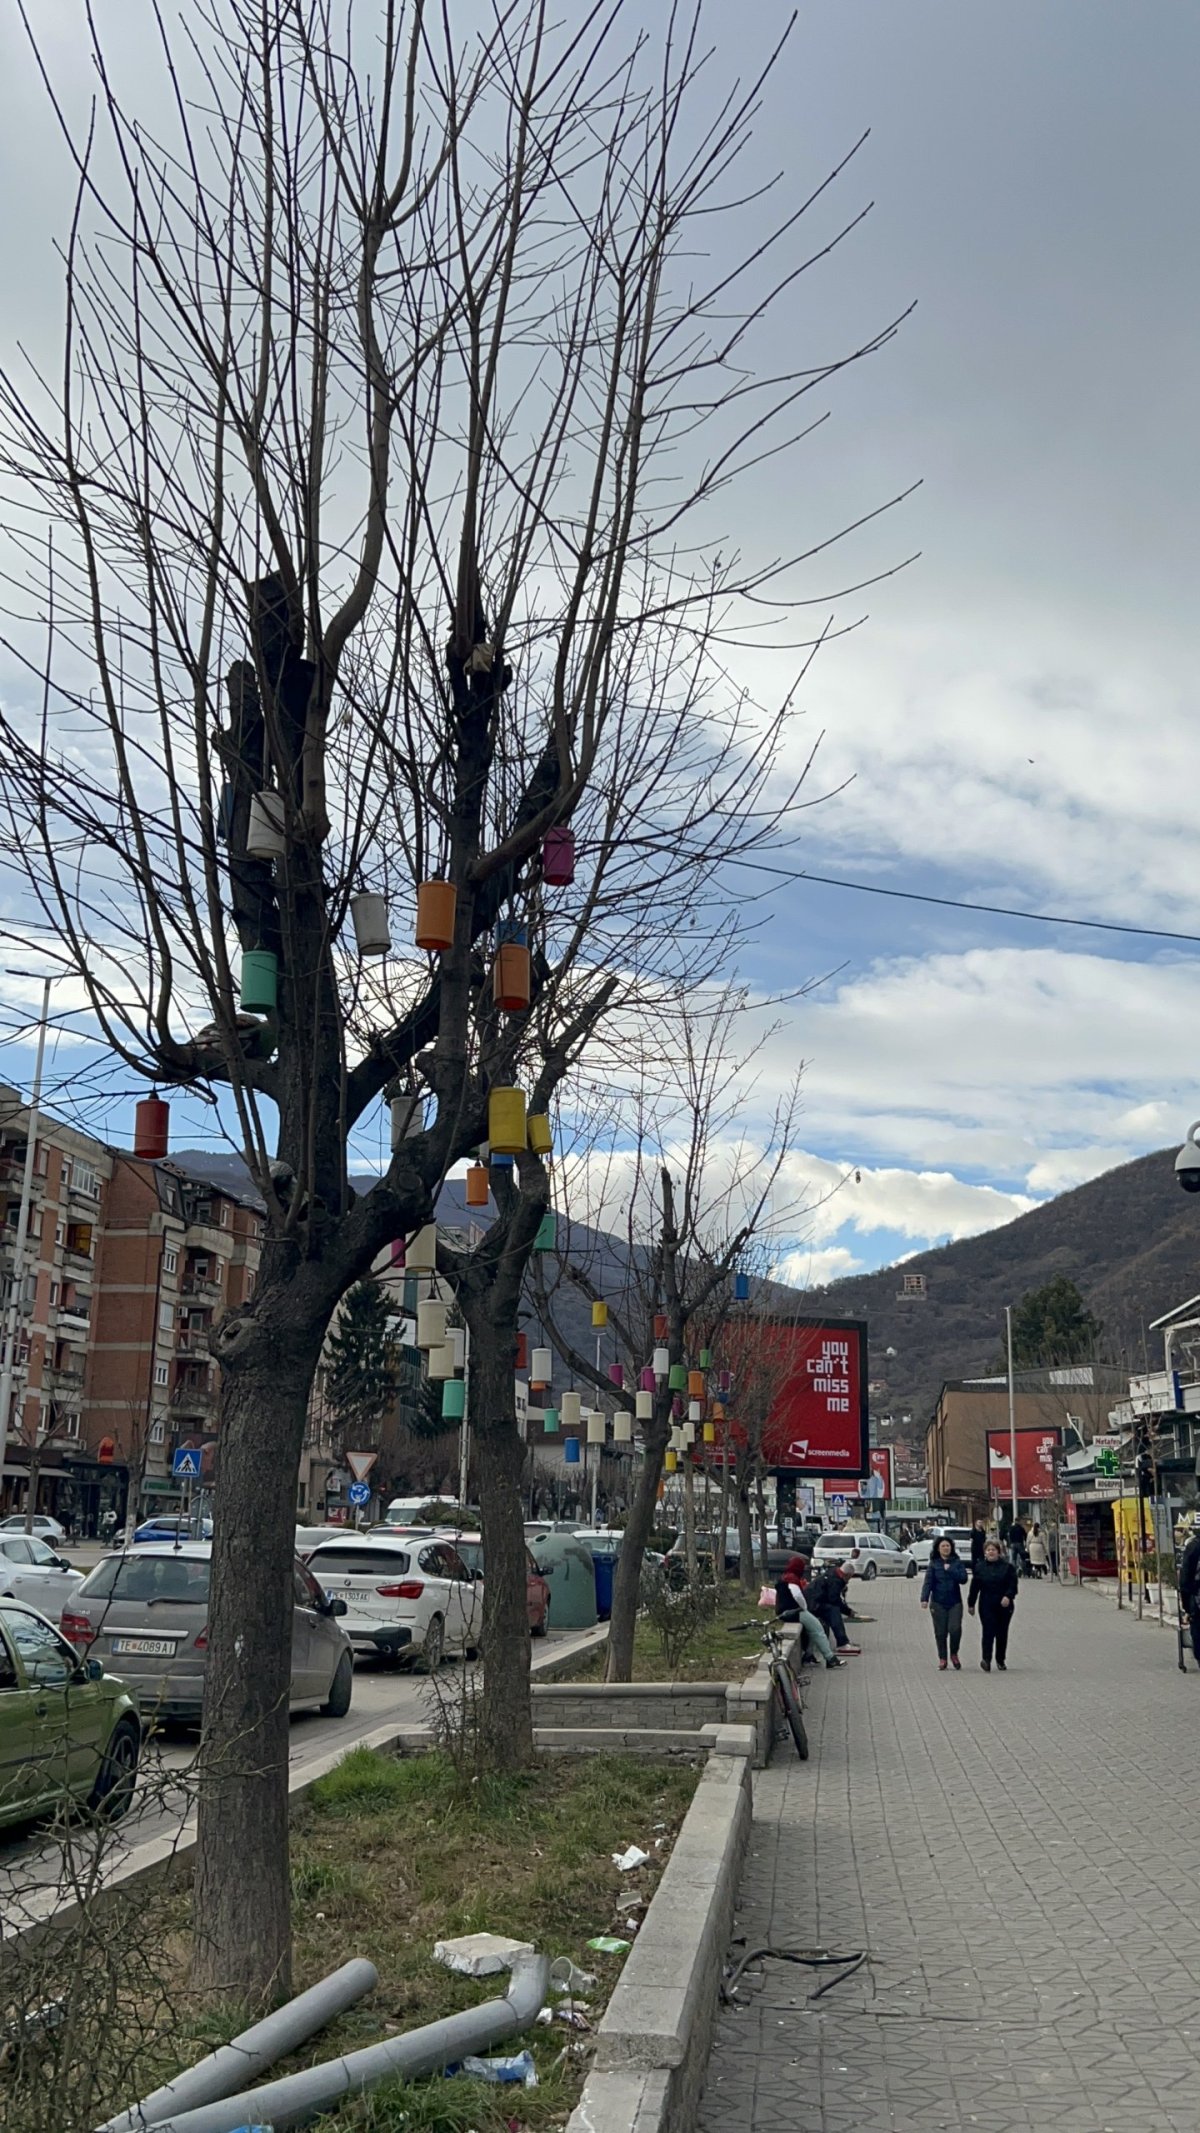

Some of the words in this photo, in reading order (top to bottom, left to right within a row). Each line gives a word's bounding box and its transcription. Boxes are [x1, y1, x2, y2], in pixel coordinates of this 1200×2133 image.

[822, 1341, 848, 1360] you
[807, 1355, 848, 1374] can't
[813, 1374, 849, 1393] miss
[827, 1397, 849, 1412] me
[808, 1449, 850, 1457] screenmedia
